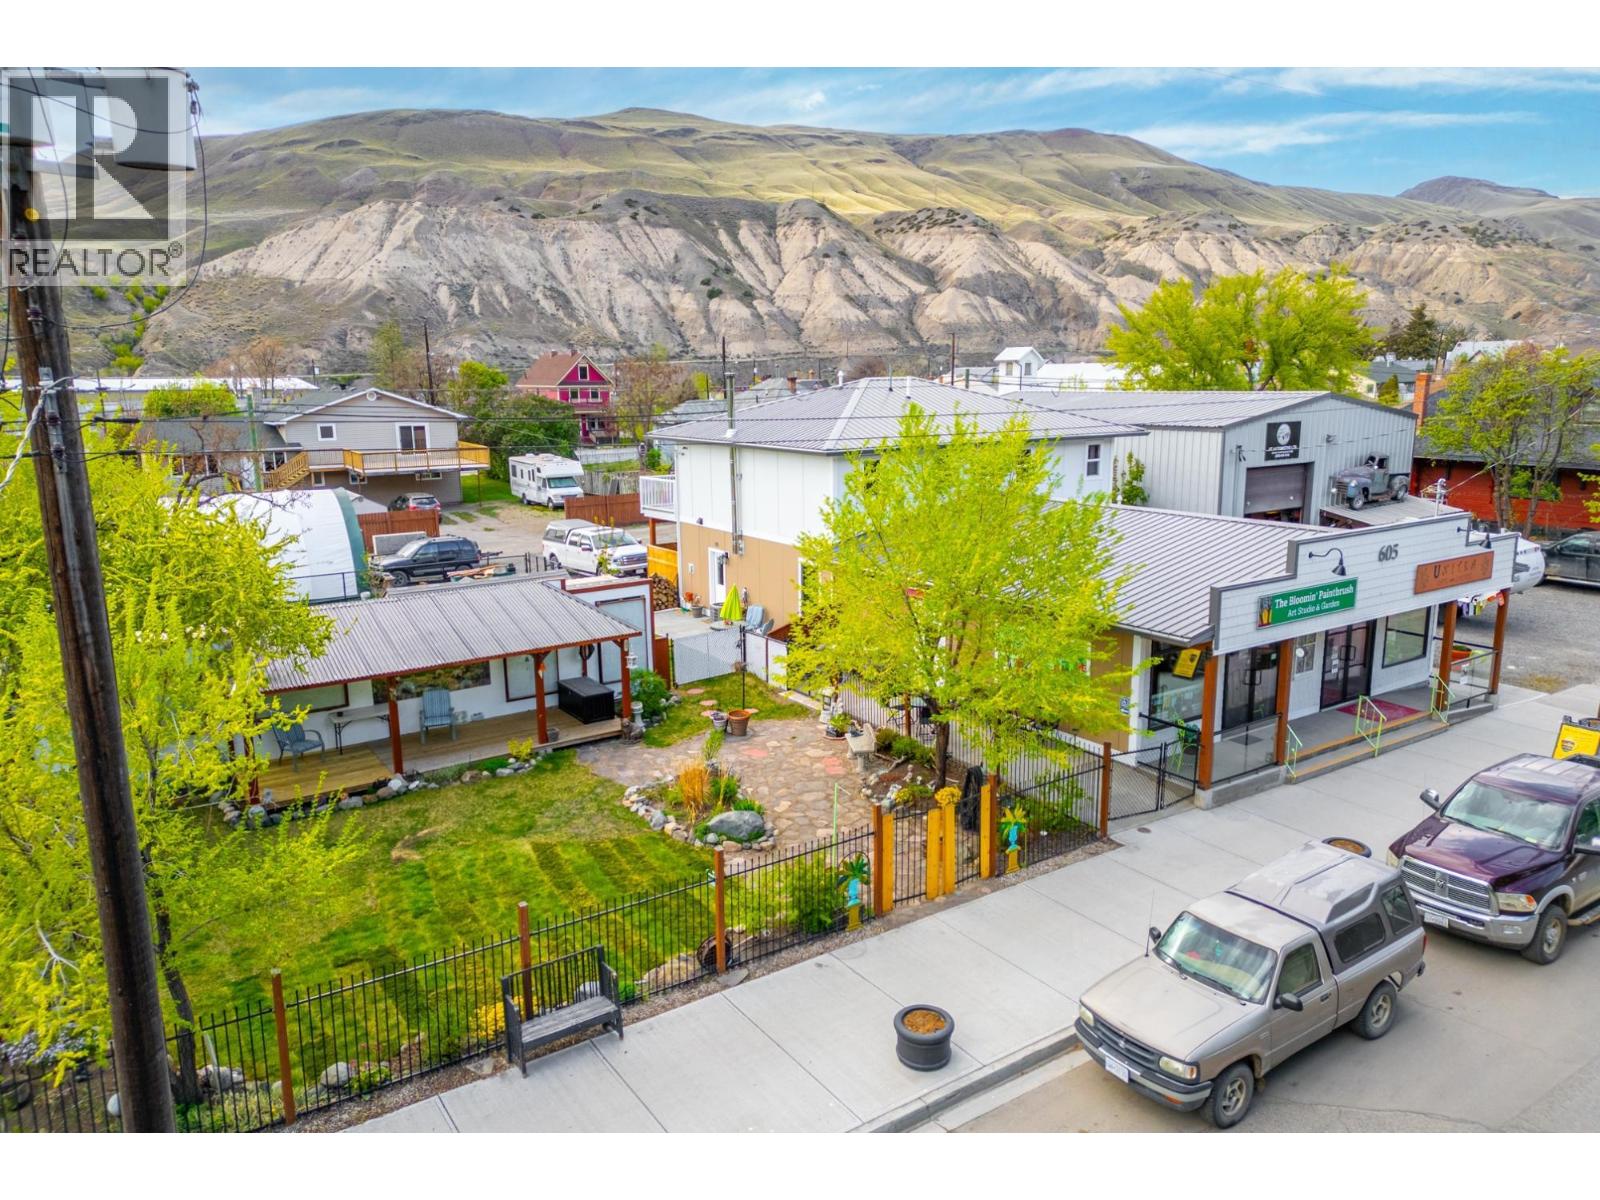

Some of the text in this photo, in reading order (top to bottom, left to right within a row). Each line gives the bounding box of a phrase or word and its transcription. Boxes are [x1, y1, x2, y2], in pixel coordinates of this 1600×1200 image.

[1378, 543, 1399, 562] 605
[1275, 584, 1354, 609] The Bloomin' Paintbrush
[1287, 608, 1297, 618] Art
[1298, 603, 1315, 615] Studio
[1320, 600, 1340, 611] Garden
